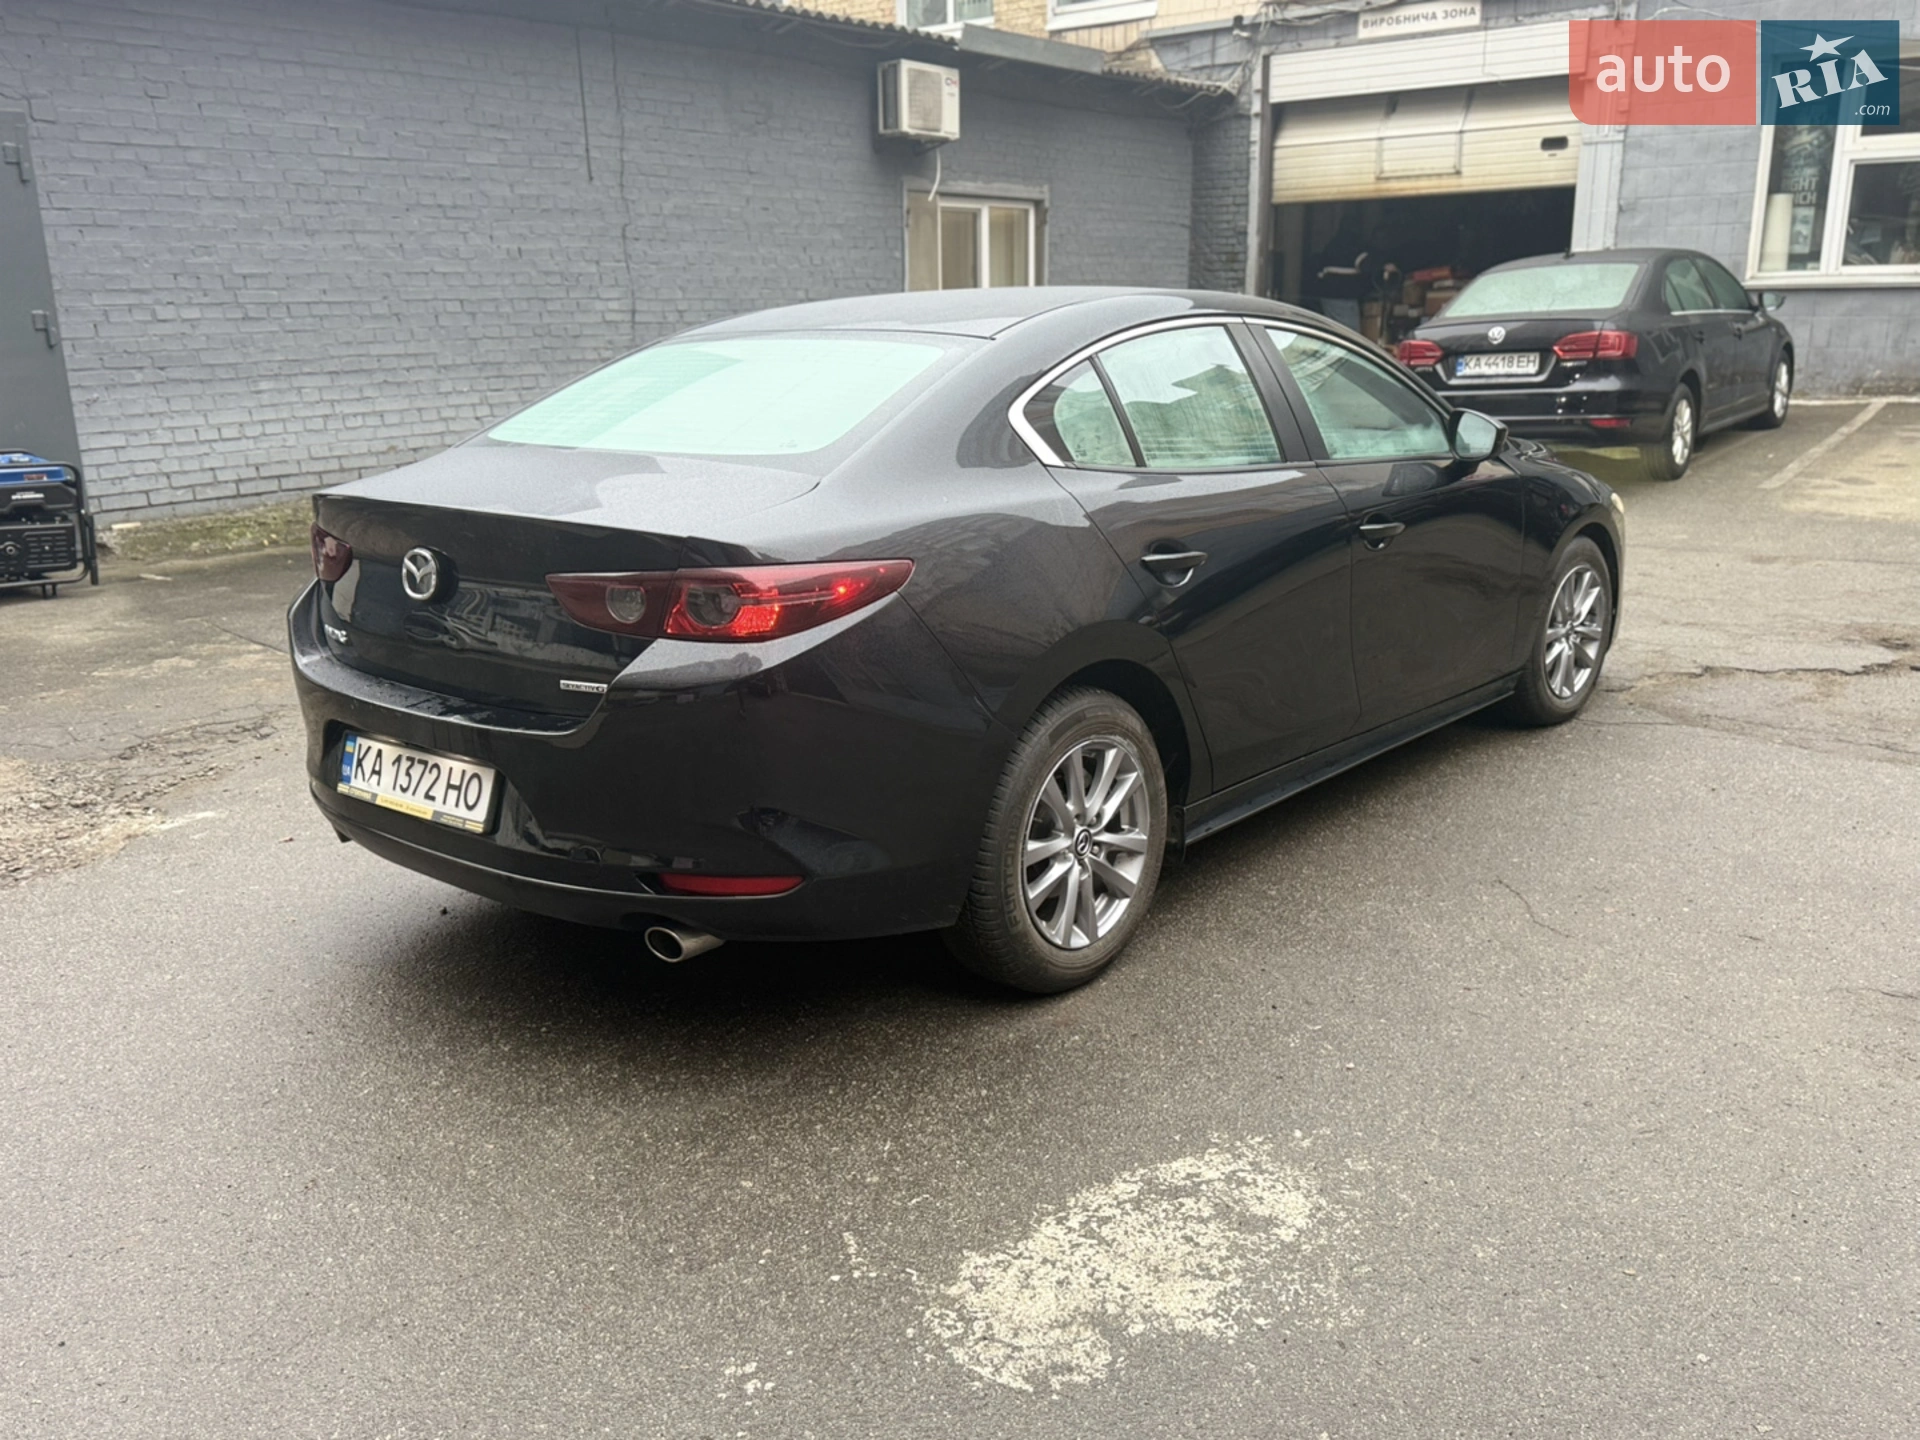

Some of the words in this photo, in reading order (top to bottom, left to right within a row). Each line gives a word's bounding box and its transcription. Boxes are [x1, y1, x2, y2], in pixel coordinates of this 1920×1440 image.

[1362, 11, 1438, 29] ВИРОБНИЧА
[1441, 6, 1477, 20] ЗОНА
[1464, 356, 1481, 371] KA
[1484, 355, 1514, 370] 4418
[1516, 354, 1536, 369] EH
[354, 743, 382, 787] KA
[392, 753, 441, 803] 1372
[443, 766, 482, 811] HO
